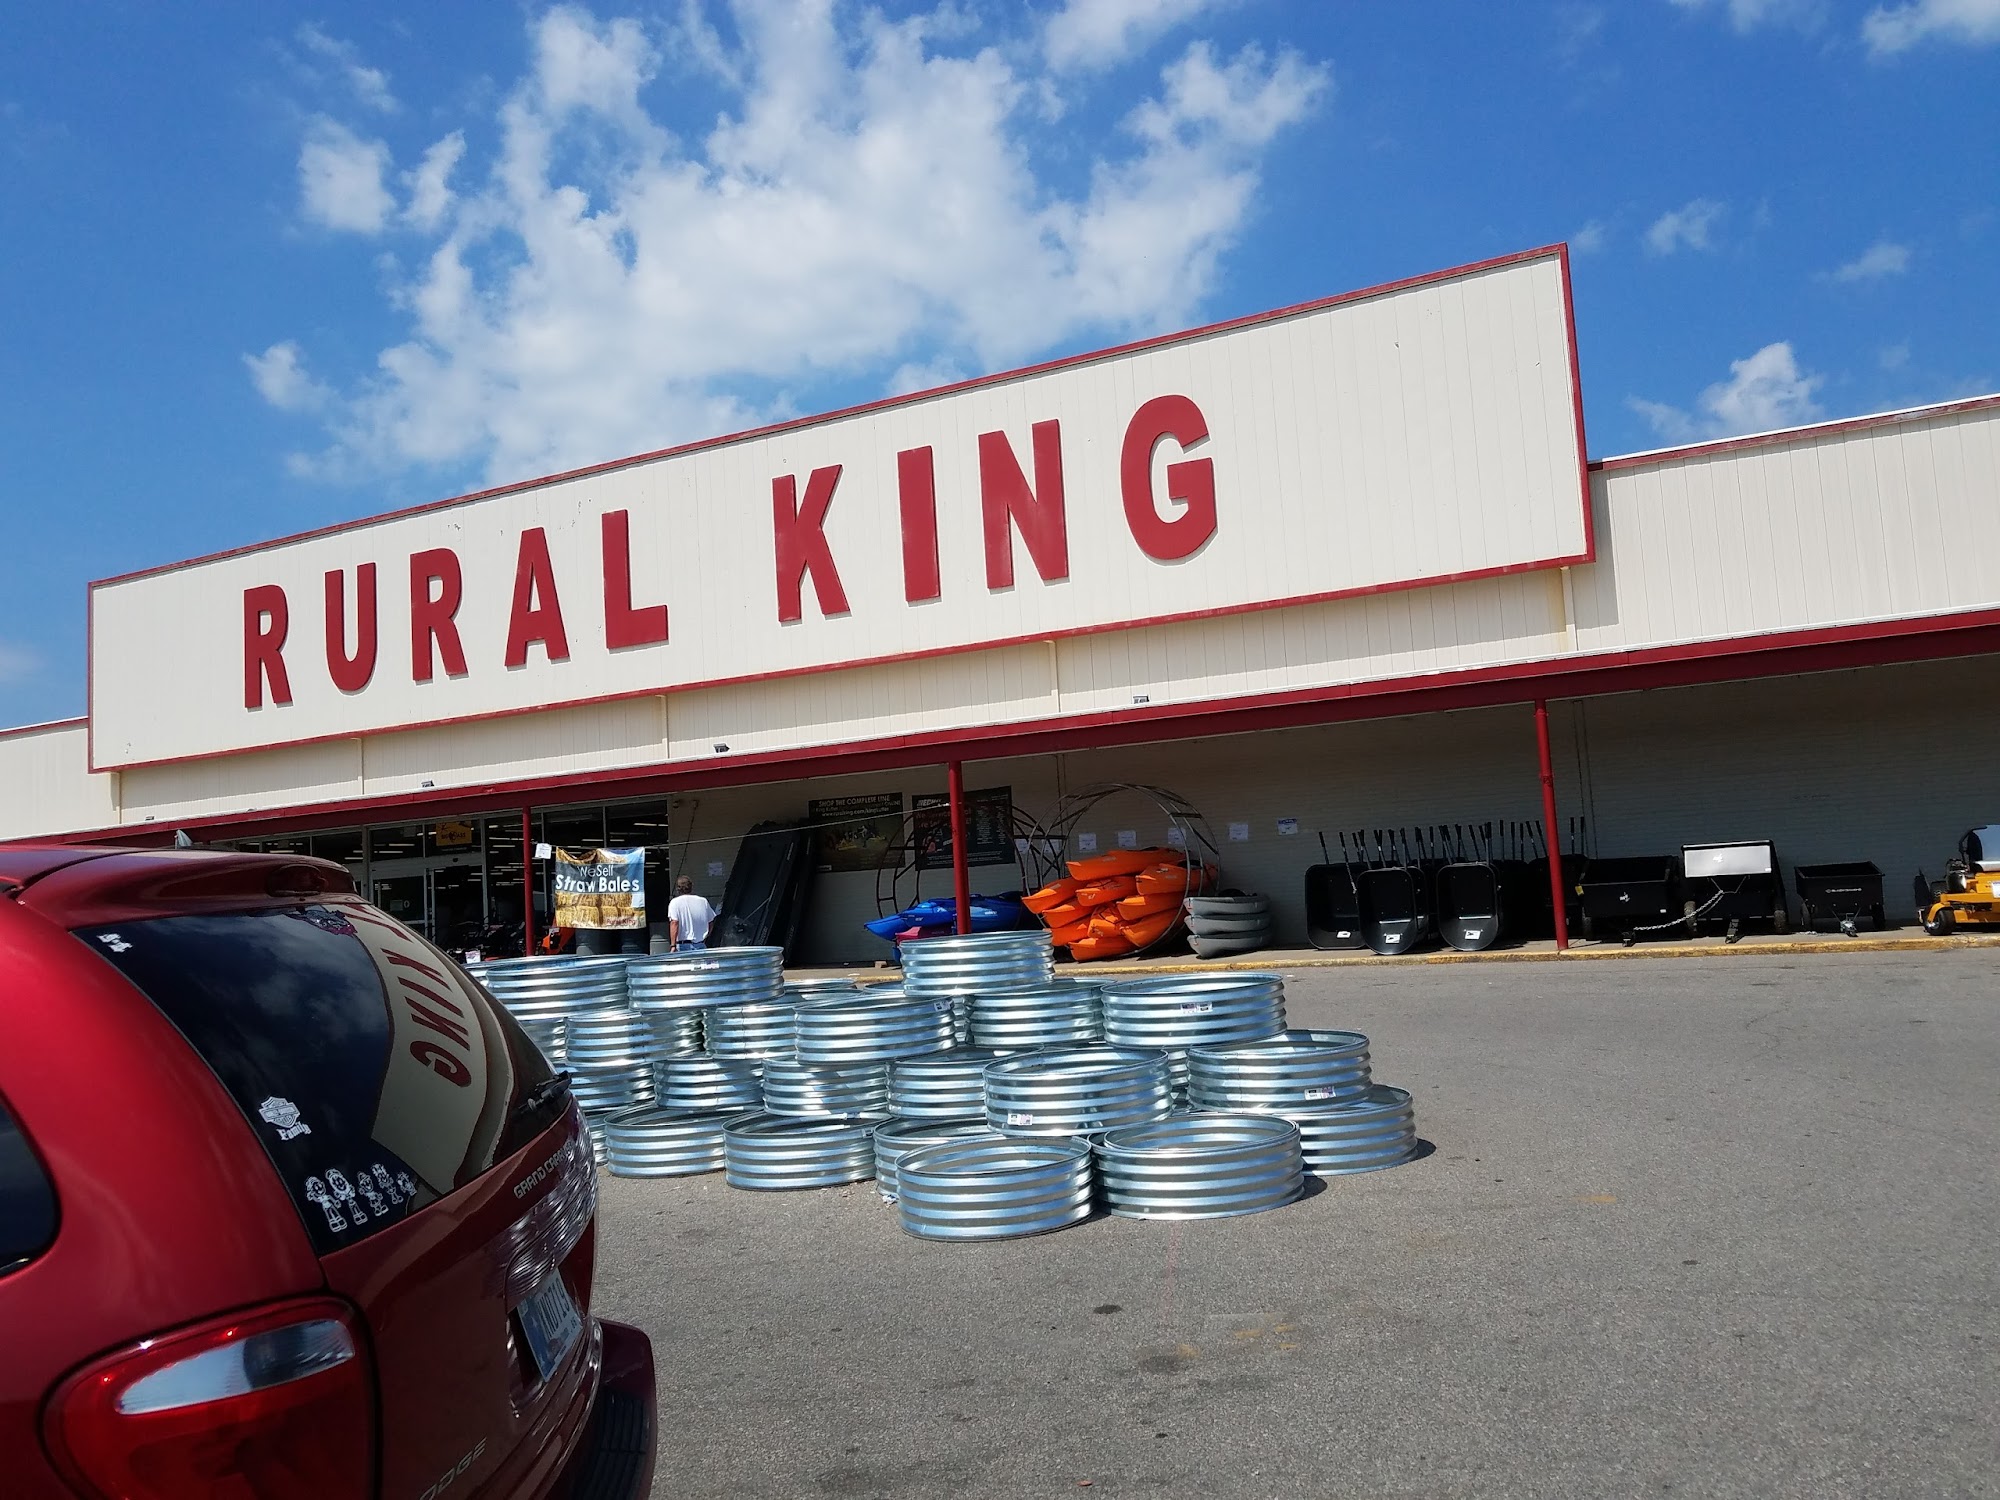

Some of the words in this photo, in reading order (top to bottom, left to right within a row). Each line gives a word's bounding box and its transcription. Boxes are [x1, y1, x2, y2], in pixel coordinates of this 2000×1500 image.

[243, 508, 669, 710] RURAL
[771, 394, 1218, 624] KING
[555, 874, 596, 893] Straw
[599, 876, 640, 893] Bales
[577, 865, 596, 878] We
[596, 864, 614, 877] Sell
[513, 1166, 546, 1199] GRAND
